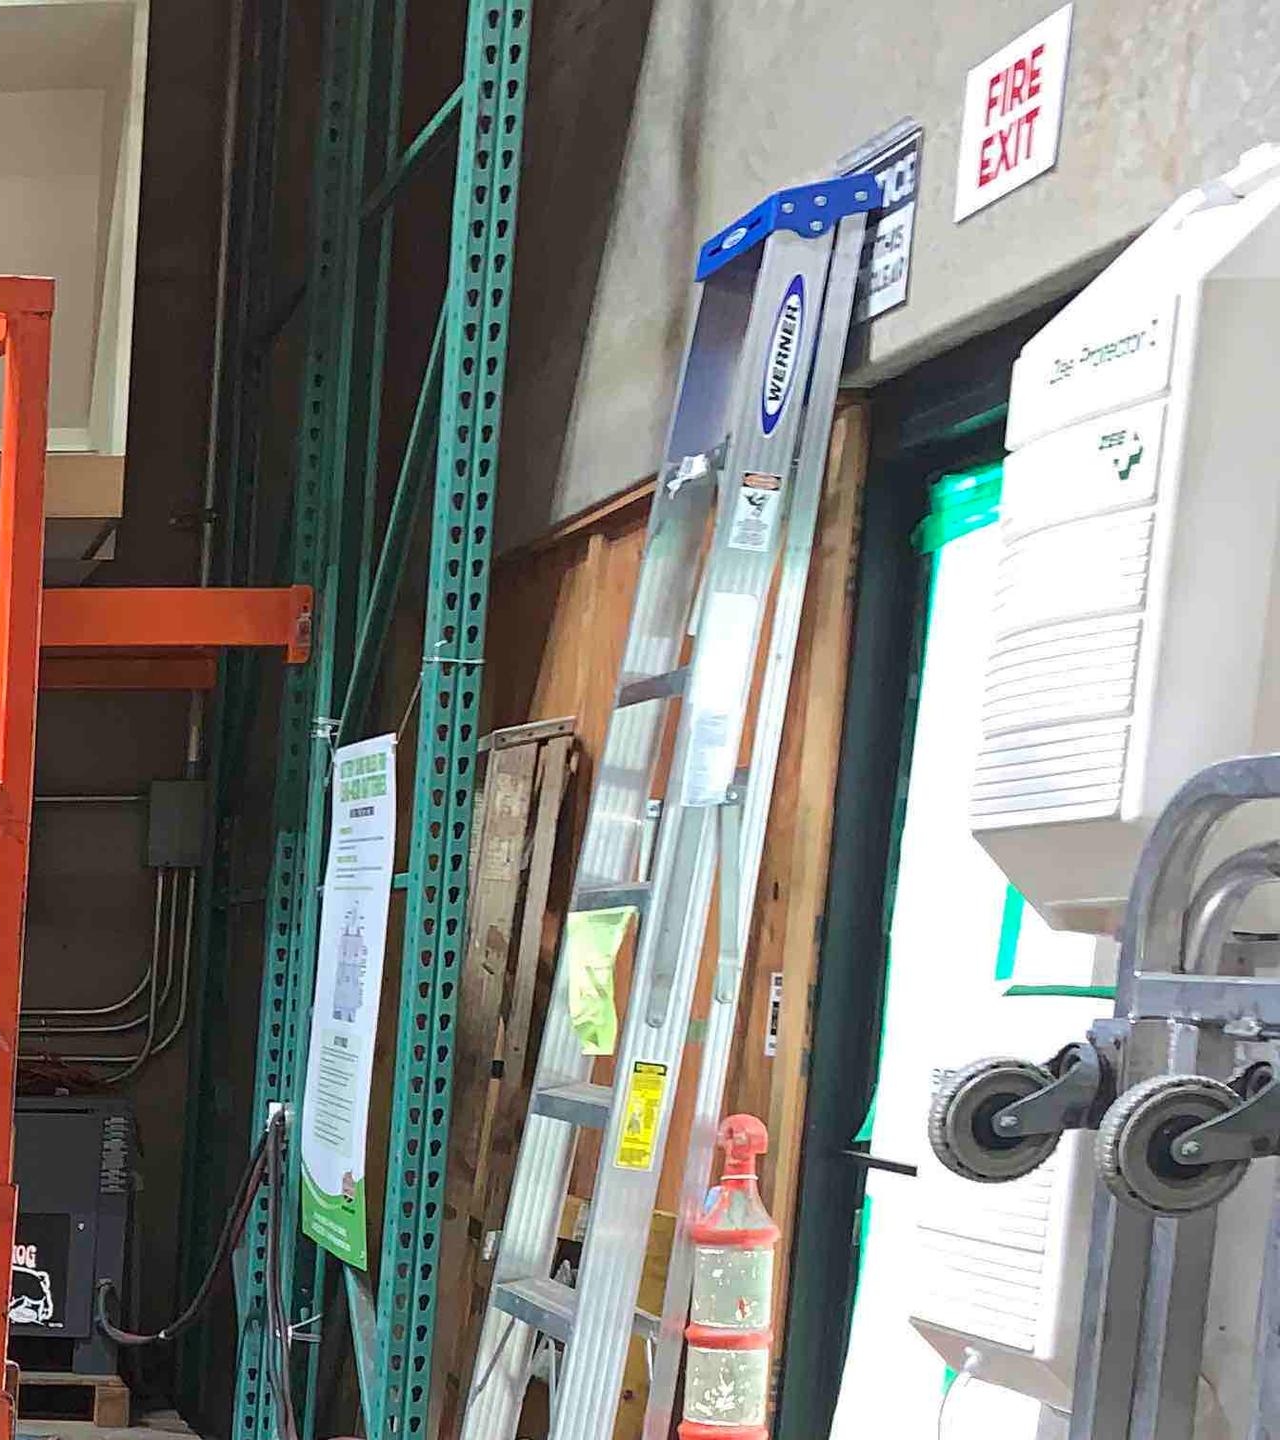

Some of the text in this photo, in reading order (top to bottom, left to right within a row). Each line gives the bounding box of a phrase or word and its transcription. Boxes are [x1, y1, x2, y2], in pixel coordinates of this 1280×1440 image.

[985, 43, 1046, 126] FIRE
[977, 106, 1041, 188] EXIT
[768, 304, 799, 403] WERNER
